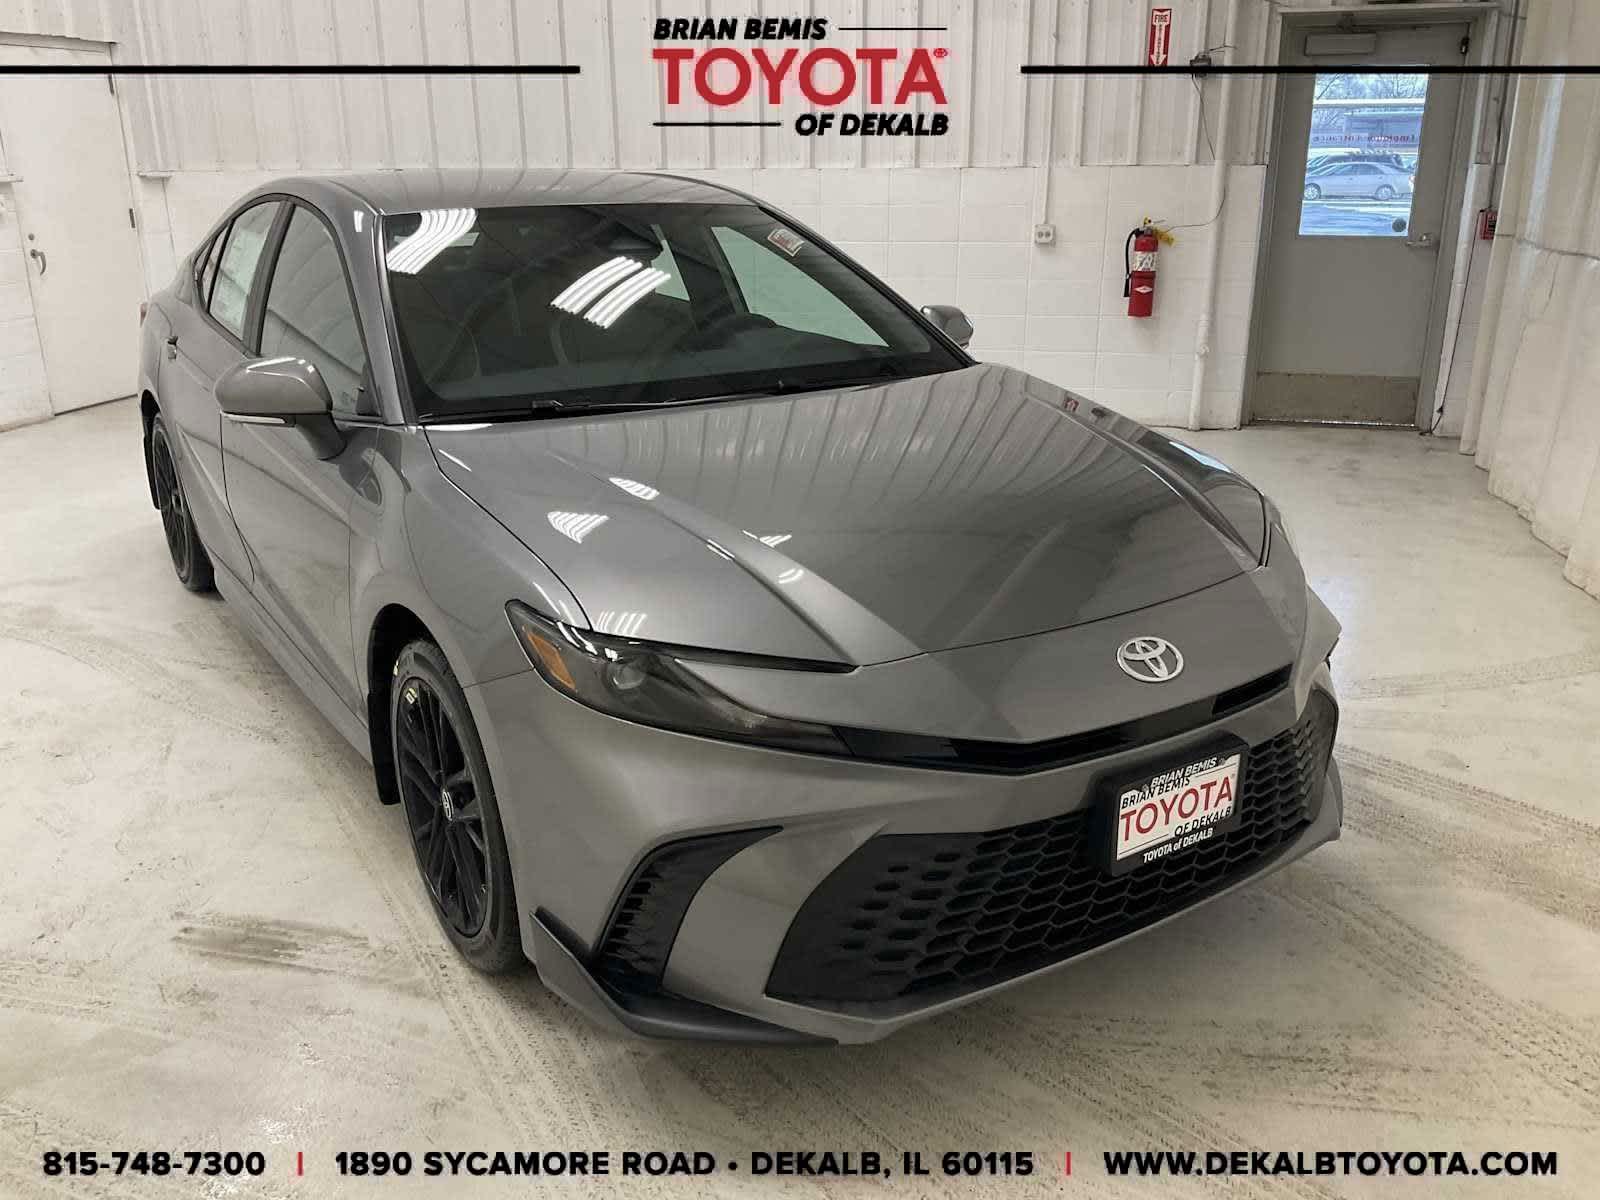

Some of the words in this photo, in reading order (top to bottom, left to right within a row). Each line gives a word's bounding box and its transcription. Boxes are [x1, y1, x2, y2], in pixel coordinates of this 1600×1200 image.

[1154, 14, 1168, 23] FIRE
[1150, 770, 1184, 788] BRIAN
[1184, 757, 1218, 777] BEMIS
[1120, 776, 1233, 841] TOYOTA
[1121, 788, 1156, 809] BRIAN
[1174, 822, 1190, 837] OF
[1143, 844, 1173, 863] TOYOTA
[1173, 839, 1182, 851] of
[1182, 828, 1214, 847] DEKALB
